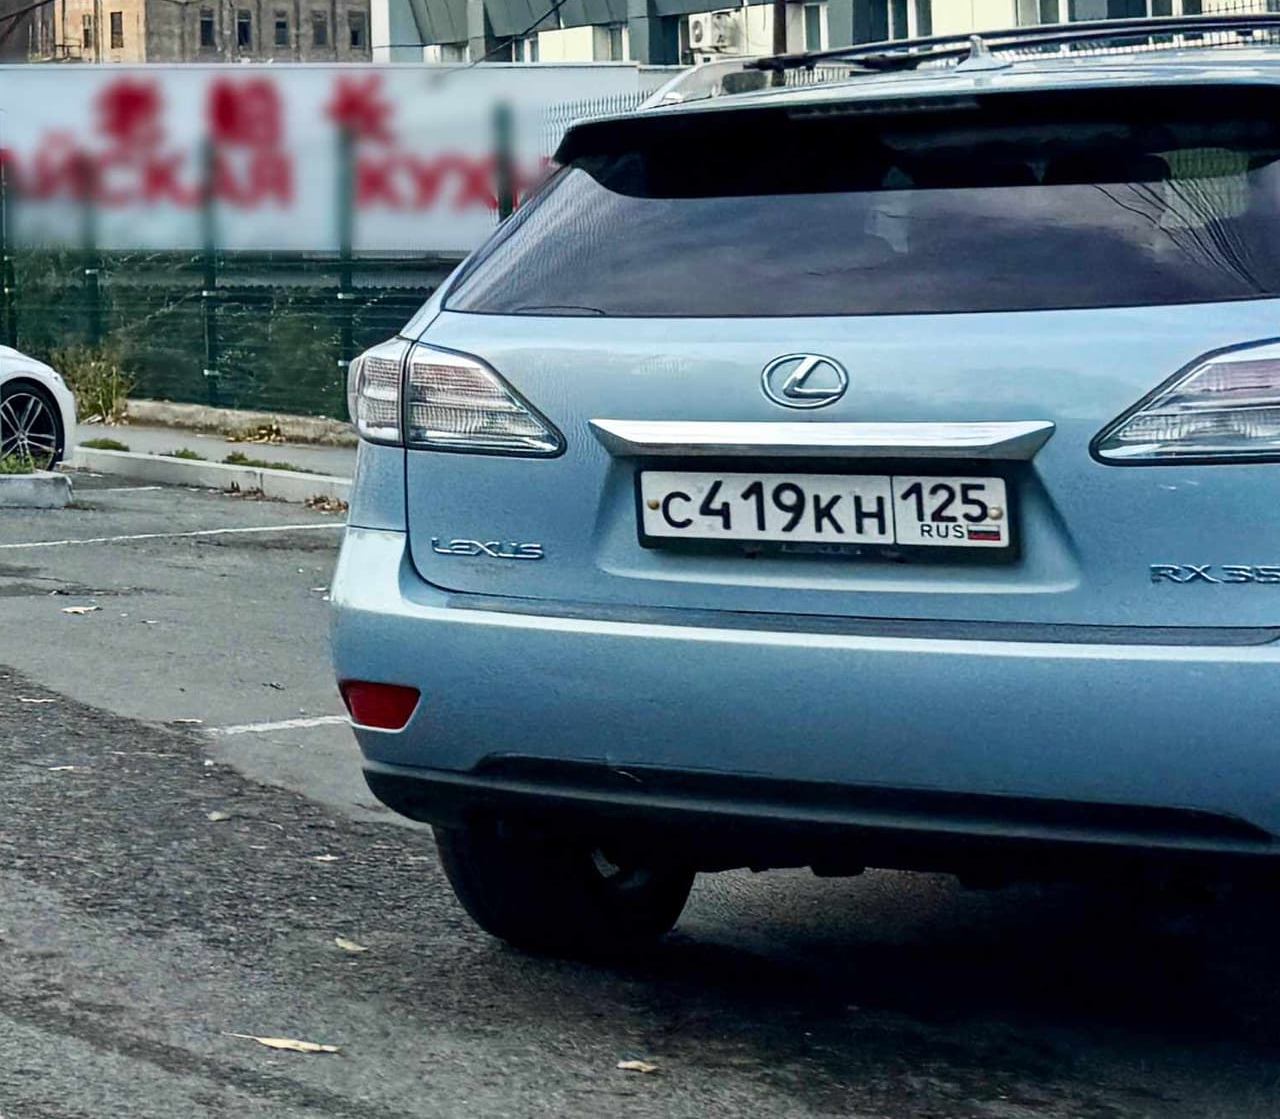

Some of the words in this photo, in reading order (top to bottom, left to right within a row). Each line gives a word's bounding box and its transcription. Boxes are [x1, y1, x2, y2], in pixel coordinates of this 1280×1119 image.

[661, 479, 888, 535] С419КН
[900, 482, 989, 523] 125
[920, 523, 965, 539] RUS
[430, 536, 545, 560] LEXUS
[1149, 563, 1224, 585] RX
